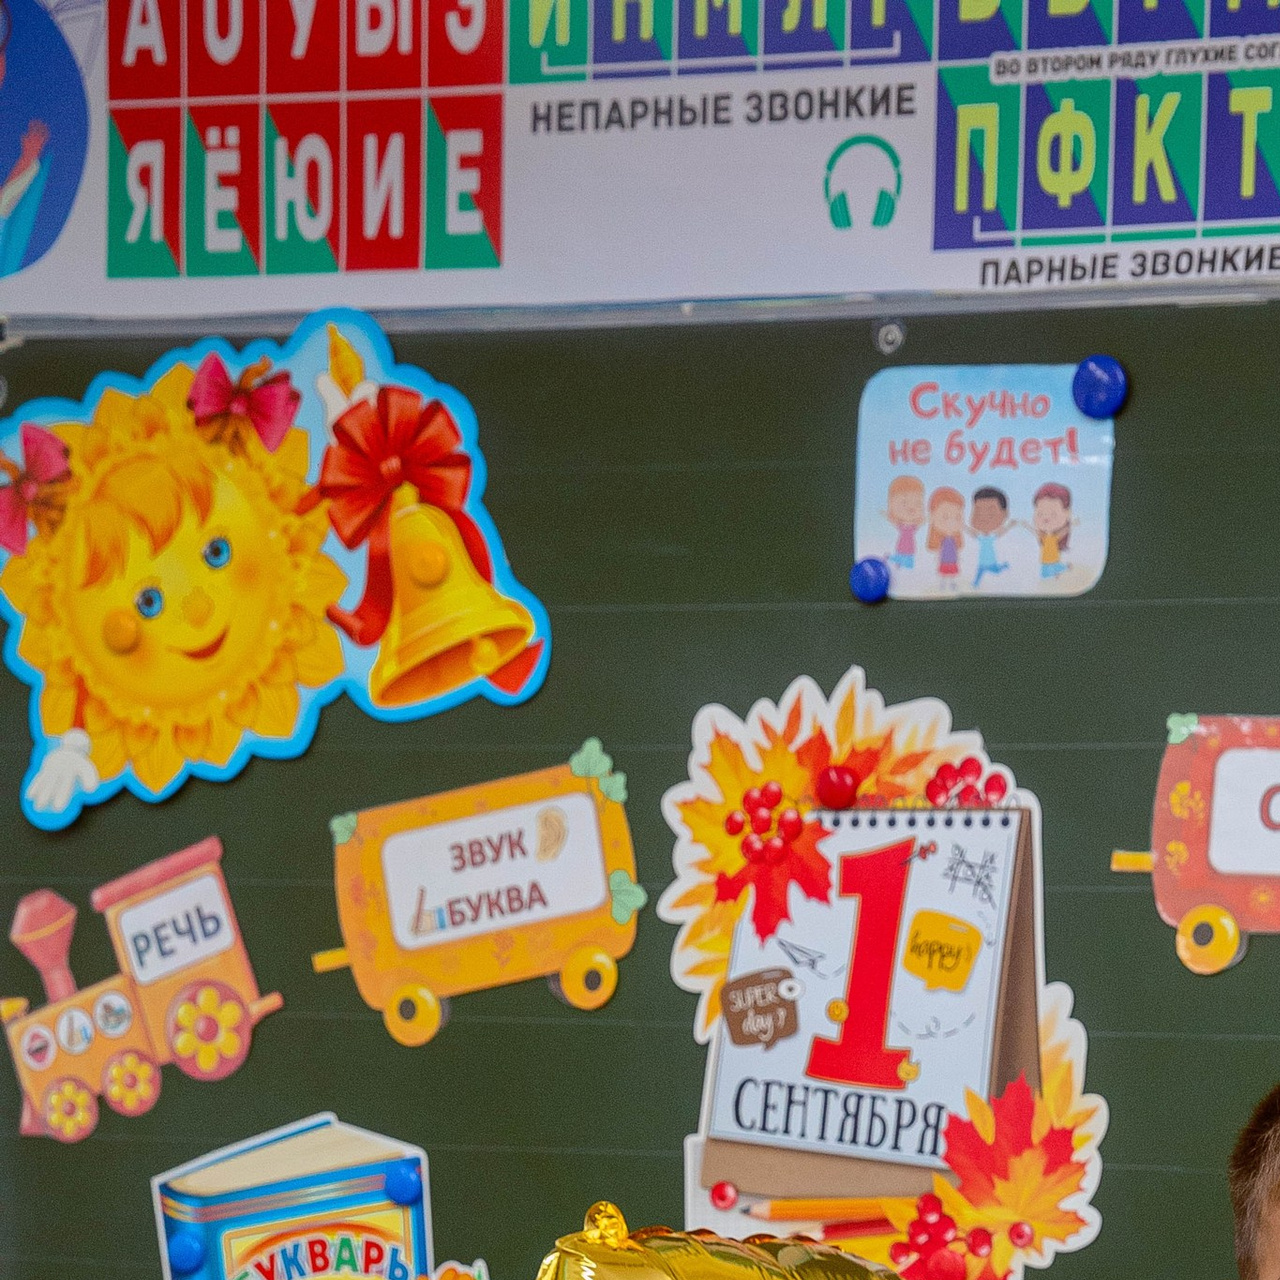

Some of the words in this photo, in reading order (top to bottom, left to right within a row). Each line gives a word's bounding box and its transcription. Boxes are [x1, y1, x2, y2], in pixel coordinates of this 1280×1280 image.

[122, 0, 167, 67] А
[996, 57, 1020, 75] ВО
[1026, 53, 1100, 74] ВТОРОМ
[1108, 49, 1157, 70] РЯДУ
[1165, 44, 1236, 65] ГЛУХИЕ
[531, 93, 733, 133] НЕПАРНЫЕ
[745, 83, 917, 123] ЗВОНКИЕ
[955, 102, 999, 214] П
[1036, 98, 1097, 208] Ф
[1132, 92, 1181, 204] К
[1229, 86, 1273, 199] Т
[125, 140, 165, 243] Я
[204, 126, 243, 253] Ё
[274, 133, 334, 242] Ю
[363, 131, 404, 240] И
[445, 128, 484, 236] Е
[981, 252, 1118, 287] ПАРНЫЕ
[909, 382, 1050, 428] Скучно
[889, 438, 931, 466] не
[944, 427, 1079, 473] будет!
[450, 828, 527, 872] ЗВУК
[448, 880, 547, 926] БУКВА
[131, 906, 221, 967] РЕЧЬ
[804, 836, 916, 1090] 1
[733, 1076, 947, 1156] СЕНТЯБРЯ
